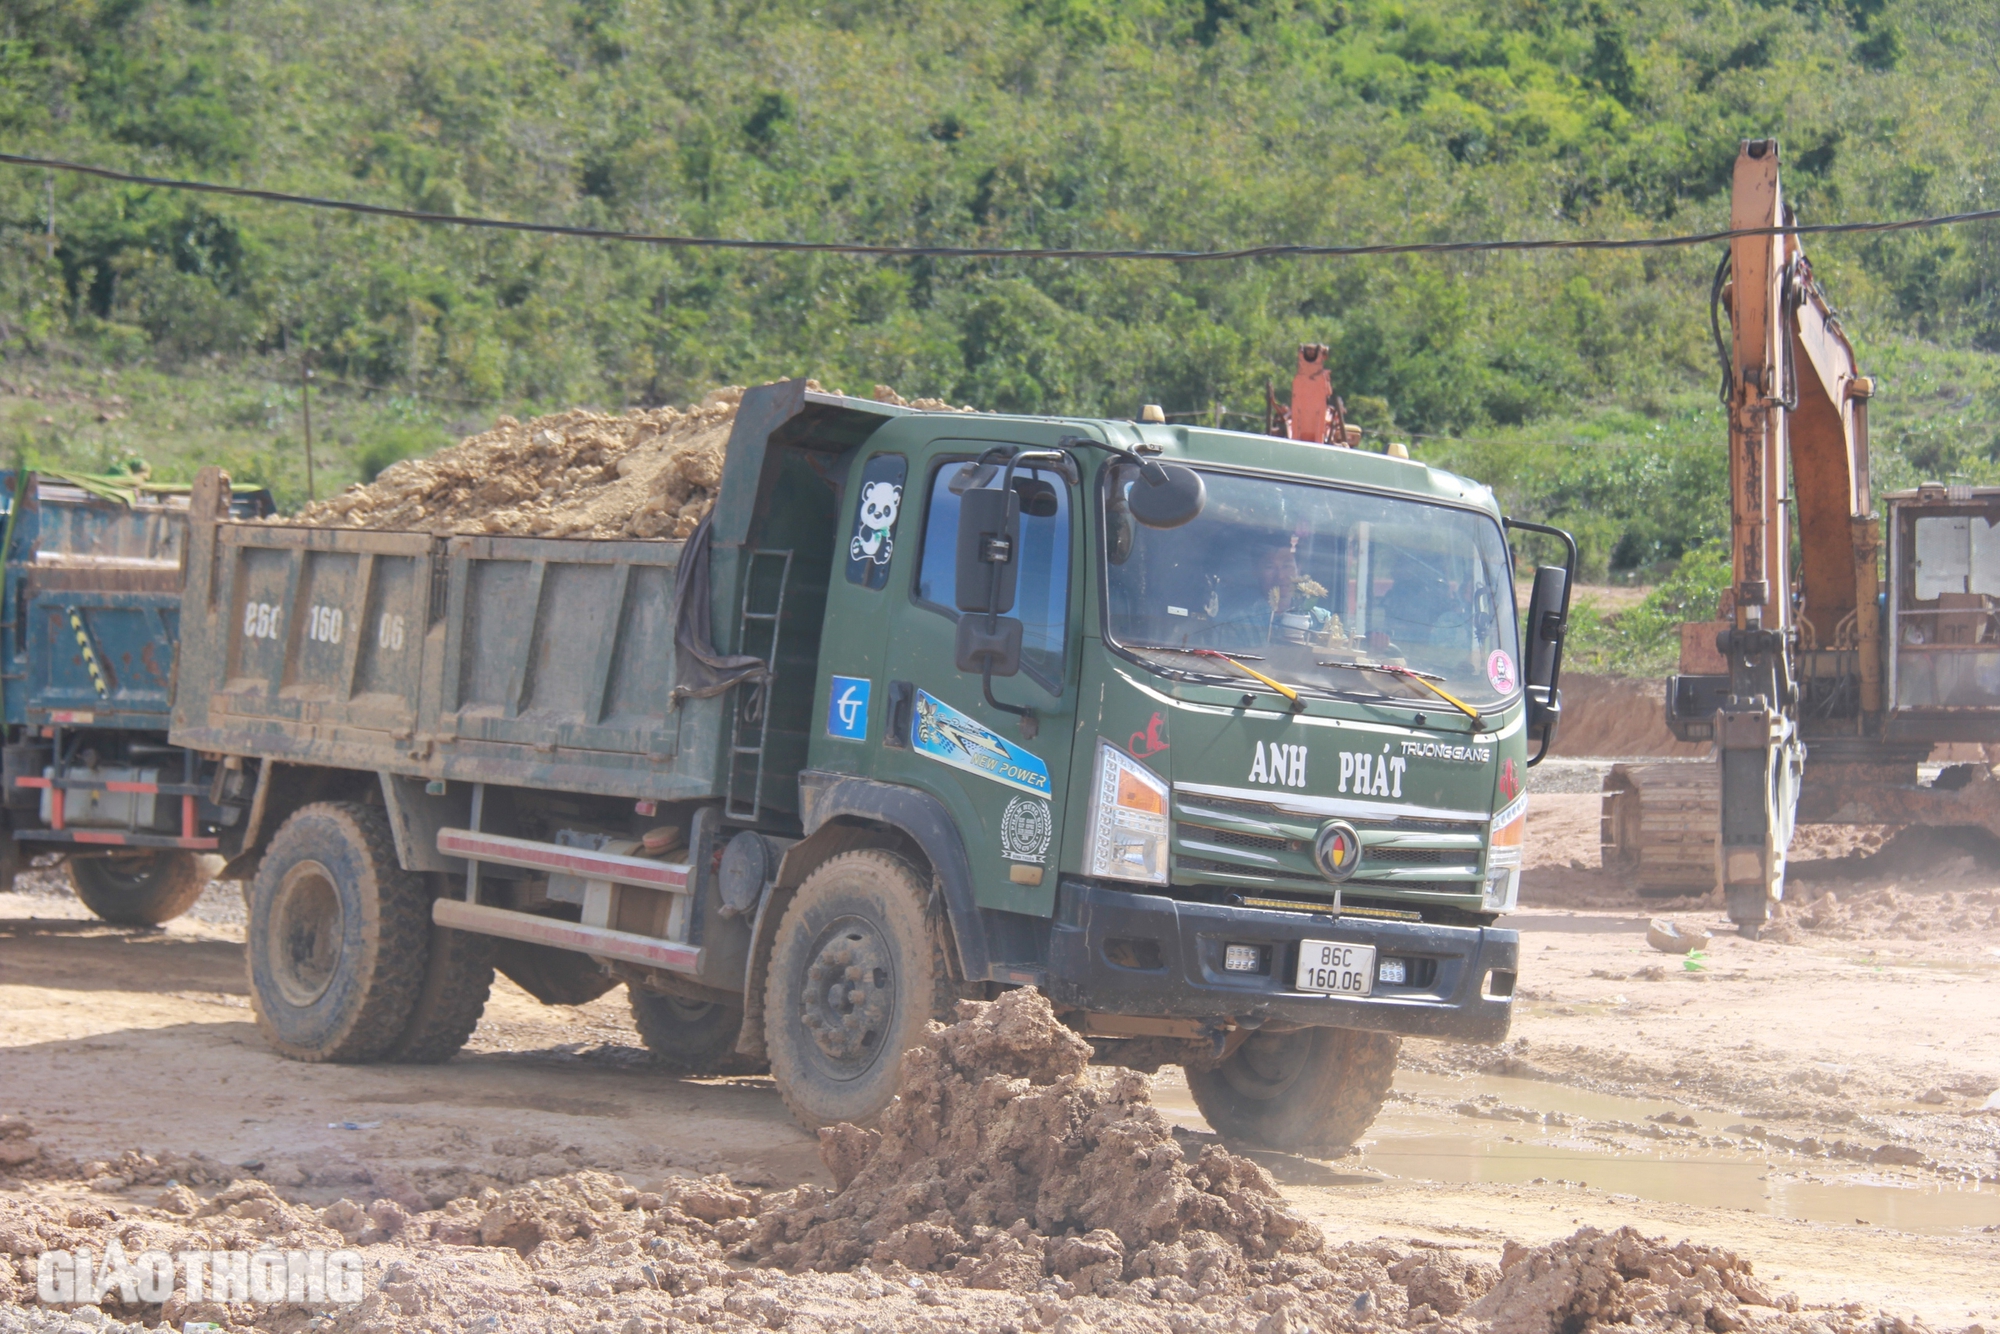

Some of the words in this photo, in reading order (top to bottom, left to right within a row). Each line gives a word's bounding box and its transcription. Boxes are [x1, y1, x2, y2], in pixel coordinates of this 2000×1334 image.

[970, 751, 999, 772] NEW
[998, 762, 1047, 788] POWER
[1248, 740, 1308, 788] ANH
[1338, 743, 1406, 798] PHÁT
[1321, 946, 1353, 967] 86C
[1308, 967, 1363, 992] 160.06
